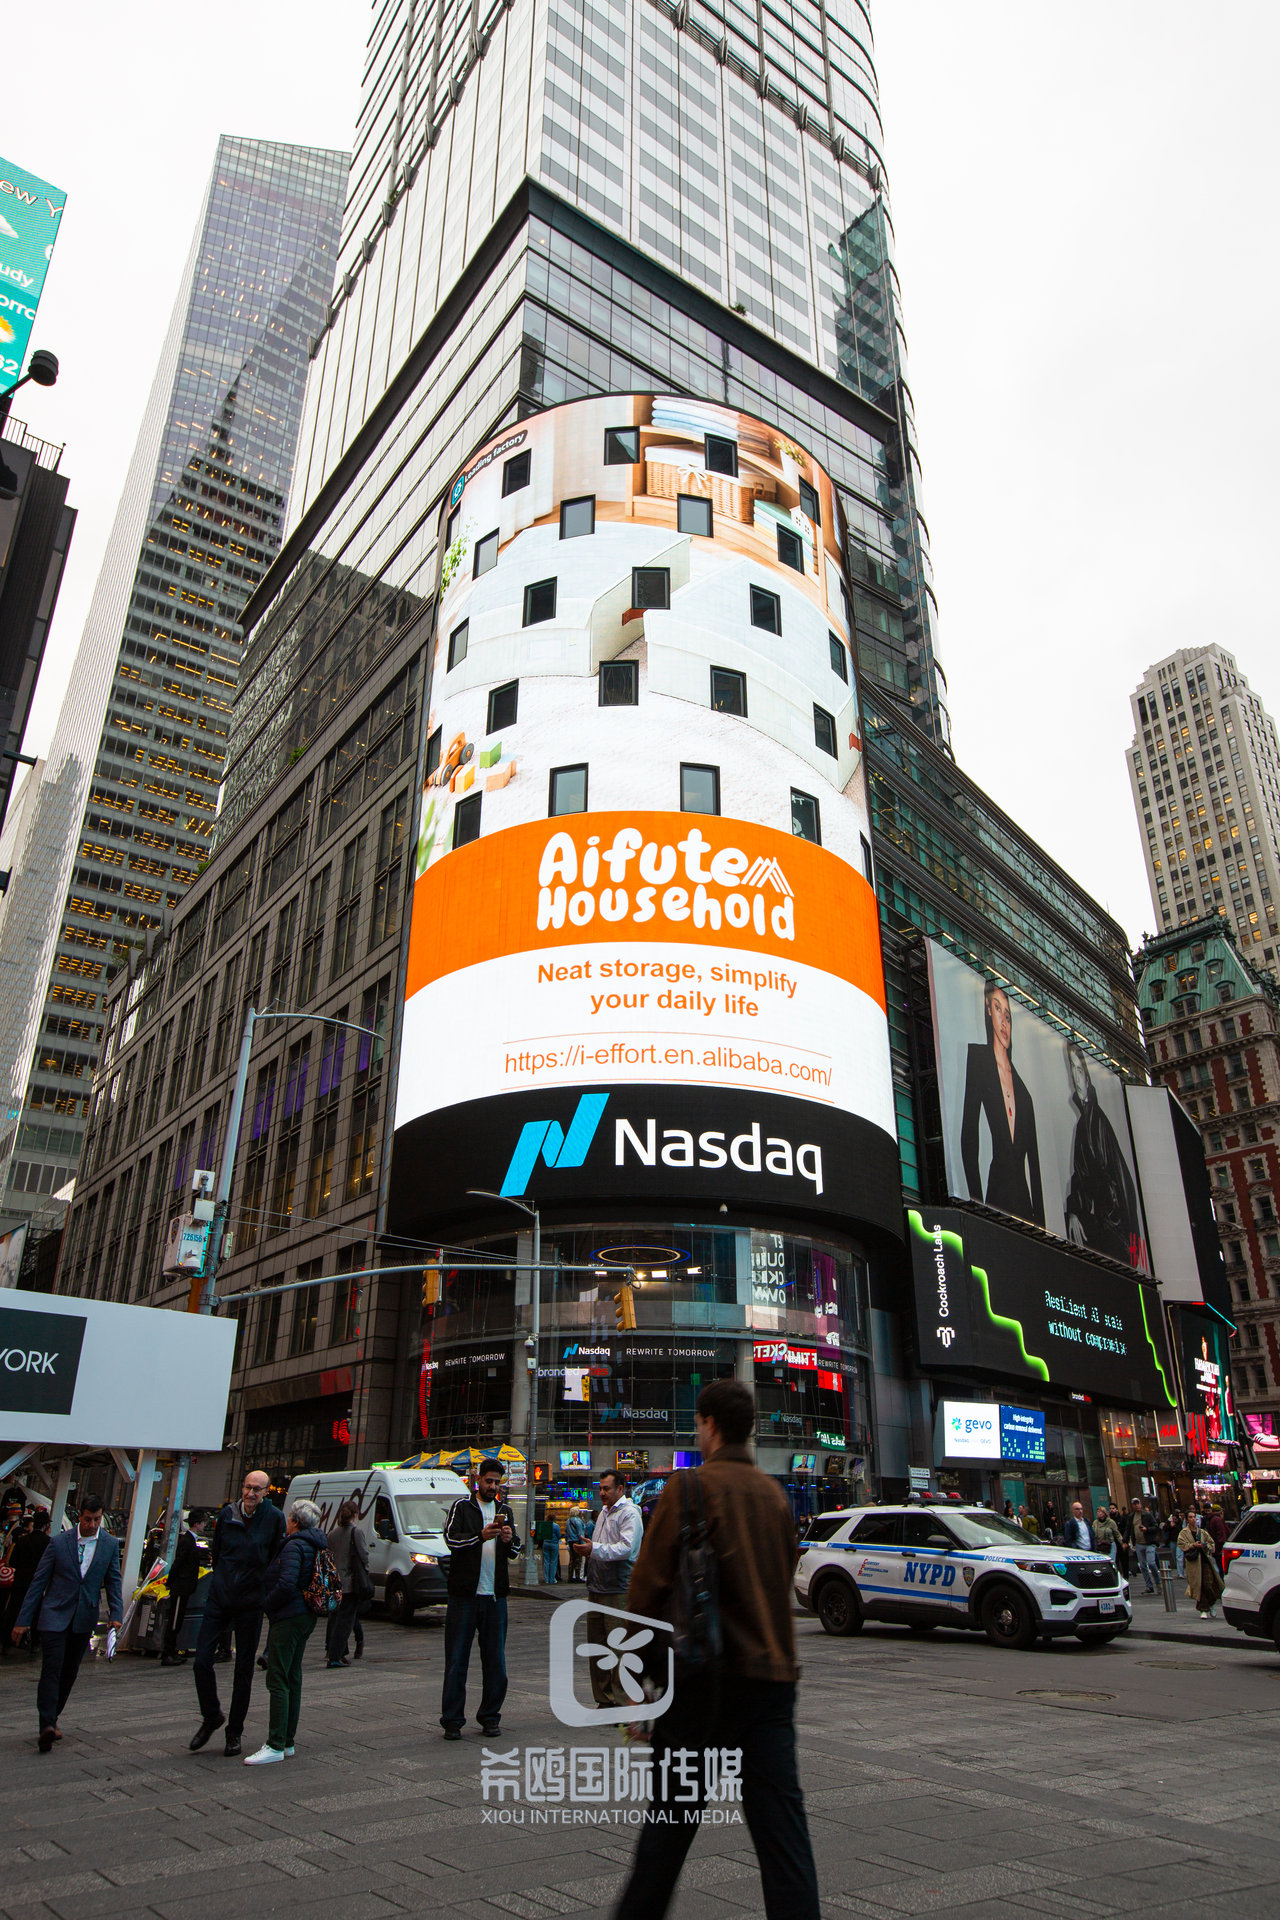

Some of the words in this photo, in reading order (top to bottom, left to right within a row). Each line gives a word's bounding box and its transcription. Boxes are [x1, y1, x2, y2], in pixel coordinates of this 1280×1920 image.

[465, 454, 492, 482] Leading
[493, 433, 524, 457] factory
[538, 828, 749, 887] Aifute
[536, 884, 796, 942] Household
[537, 960, 592, 984] Neat
[600, 958, 703, 983] storage,
[710, 964, 798, 998] simplify
[590, 993, 647, 1014] your
[657, 990, 716, 1016] daily
[724, 993, 759, 1017] life
[505, 1042, 832, 1087] https://i-effort.en.alibaba.com/
[614, 1118, 824, 1195] Nasdaq
[933, 1224, 943, 1252] Labs
[934, 1254, 949, 1317] Cockroach
[1047, 1319, 1083, 1342] without
[578, 1346, 611, 1357] Nasdaq
[626, 1348, 664, 1356] REWRITE
[668, 1348, 717, 1357] TOMORROW
[622, 1408, 669, 1421] Nasdaq
[965, 1419, 992, 1433] gevo
[984, 1555, 1006, 1563] POLICE
[904, 1561, 956, 1587] NYPD
